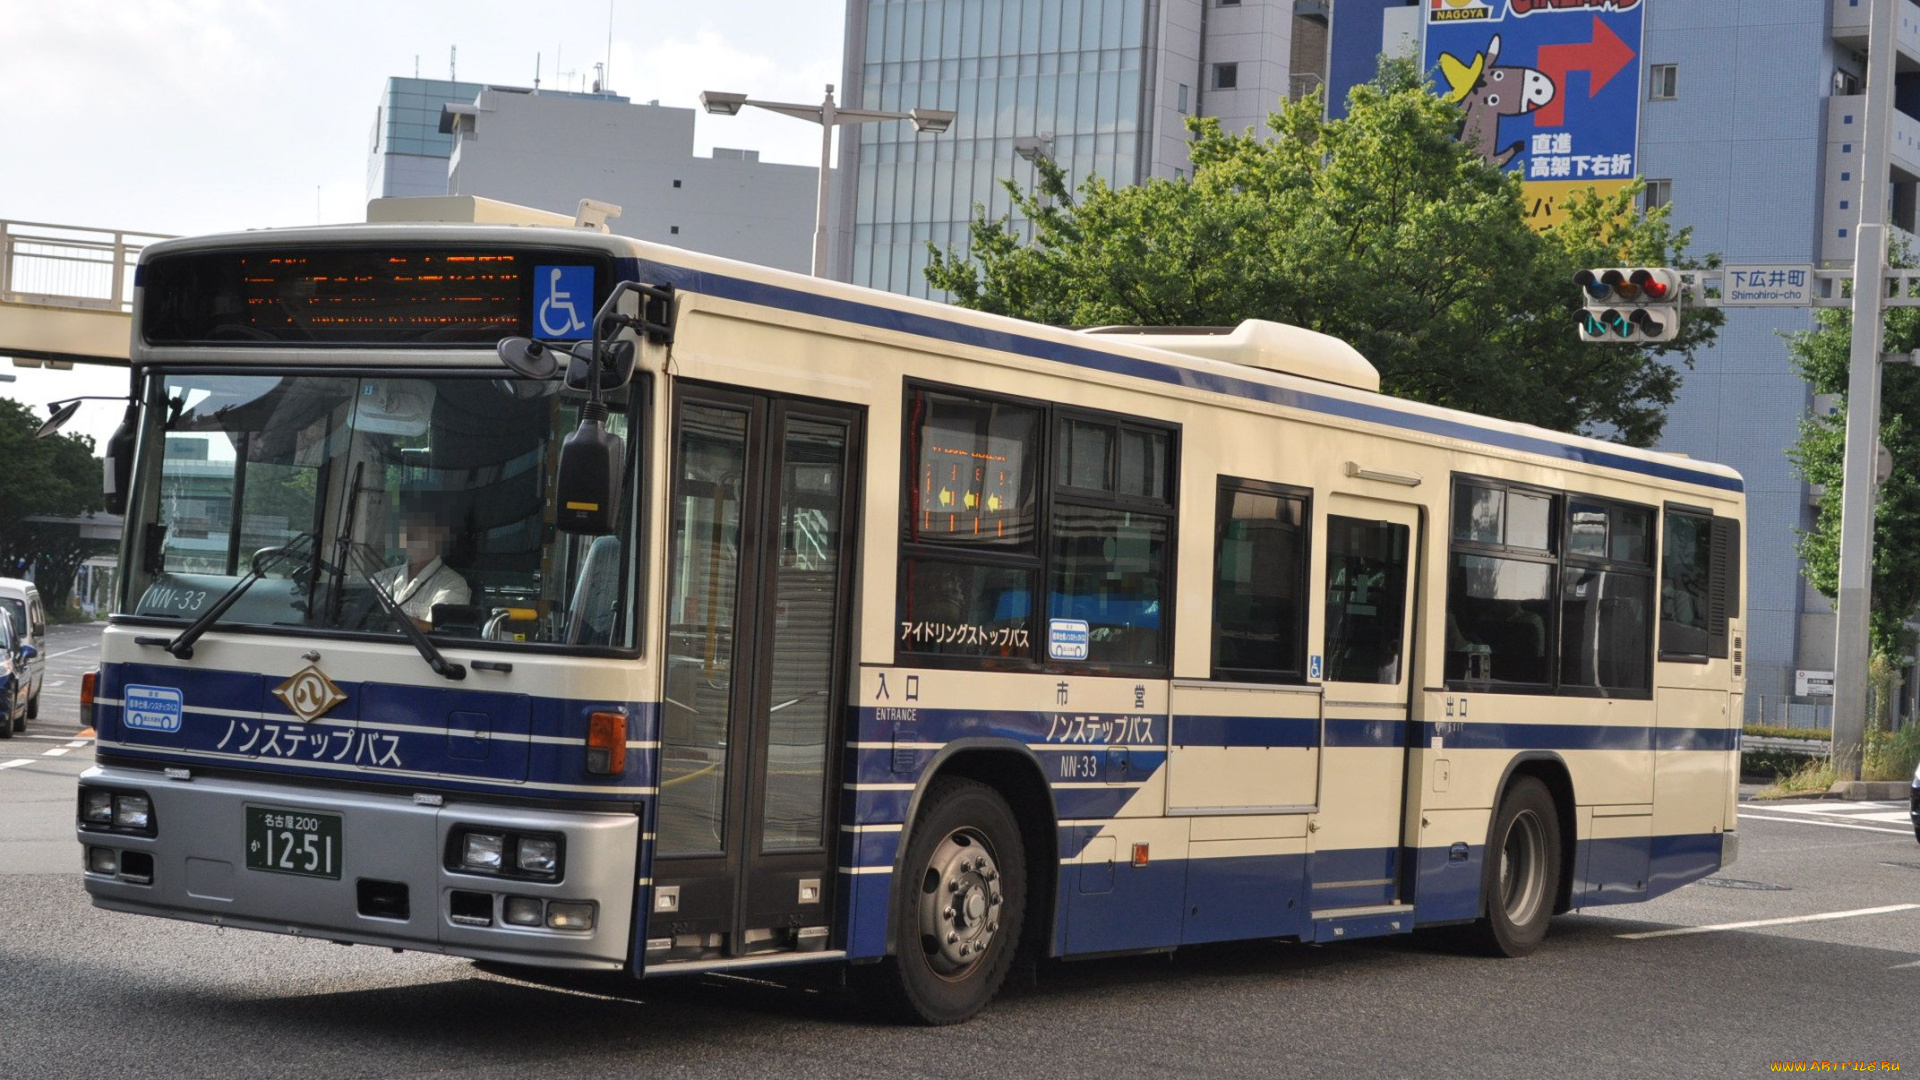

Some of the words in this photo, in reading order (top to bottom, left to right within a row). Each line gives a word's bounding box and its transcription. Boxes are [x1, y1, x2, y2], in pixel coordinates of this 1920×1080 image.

[1436, 9, 1484, 20] NAGOYA
[1532, 132, 1572, 155] 直進
[1530, 153, 1632, 178] 高架下右折
[1730, 269, 1806, 288] 下広井町
[1731, 289, 1802, 301] Shimohiroi-cho
[145, 587, 207, 611] NN-33
[901, 620, 1030, 648] アイドリングストップバス
[875, 672, 919, 702] 入口
[875, 707, 917, 721] ENTRANCE
[1446, 696, 1467, 717] 出口
[1045, 714, 1153, 743] ノンステップバス
[216, 719, 402, 767] ノンステップバス
[1060, 755, 1097, 778] NN-33
[250, 840, 261, 852] か
[267, 829, 331, 873] 12-51
